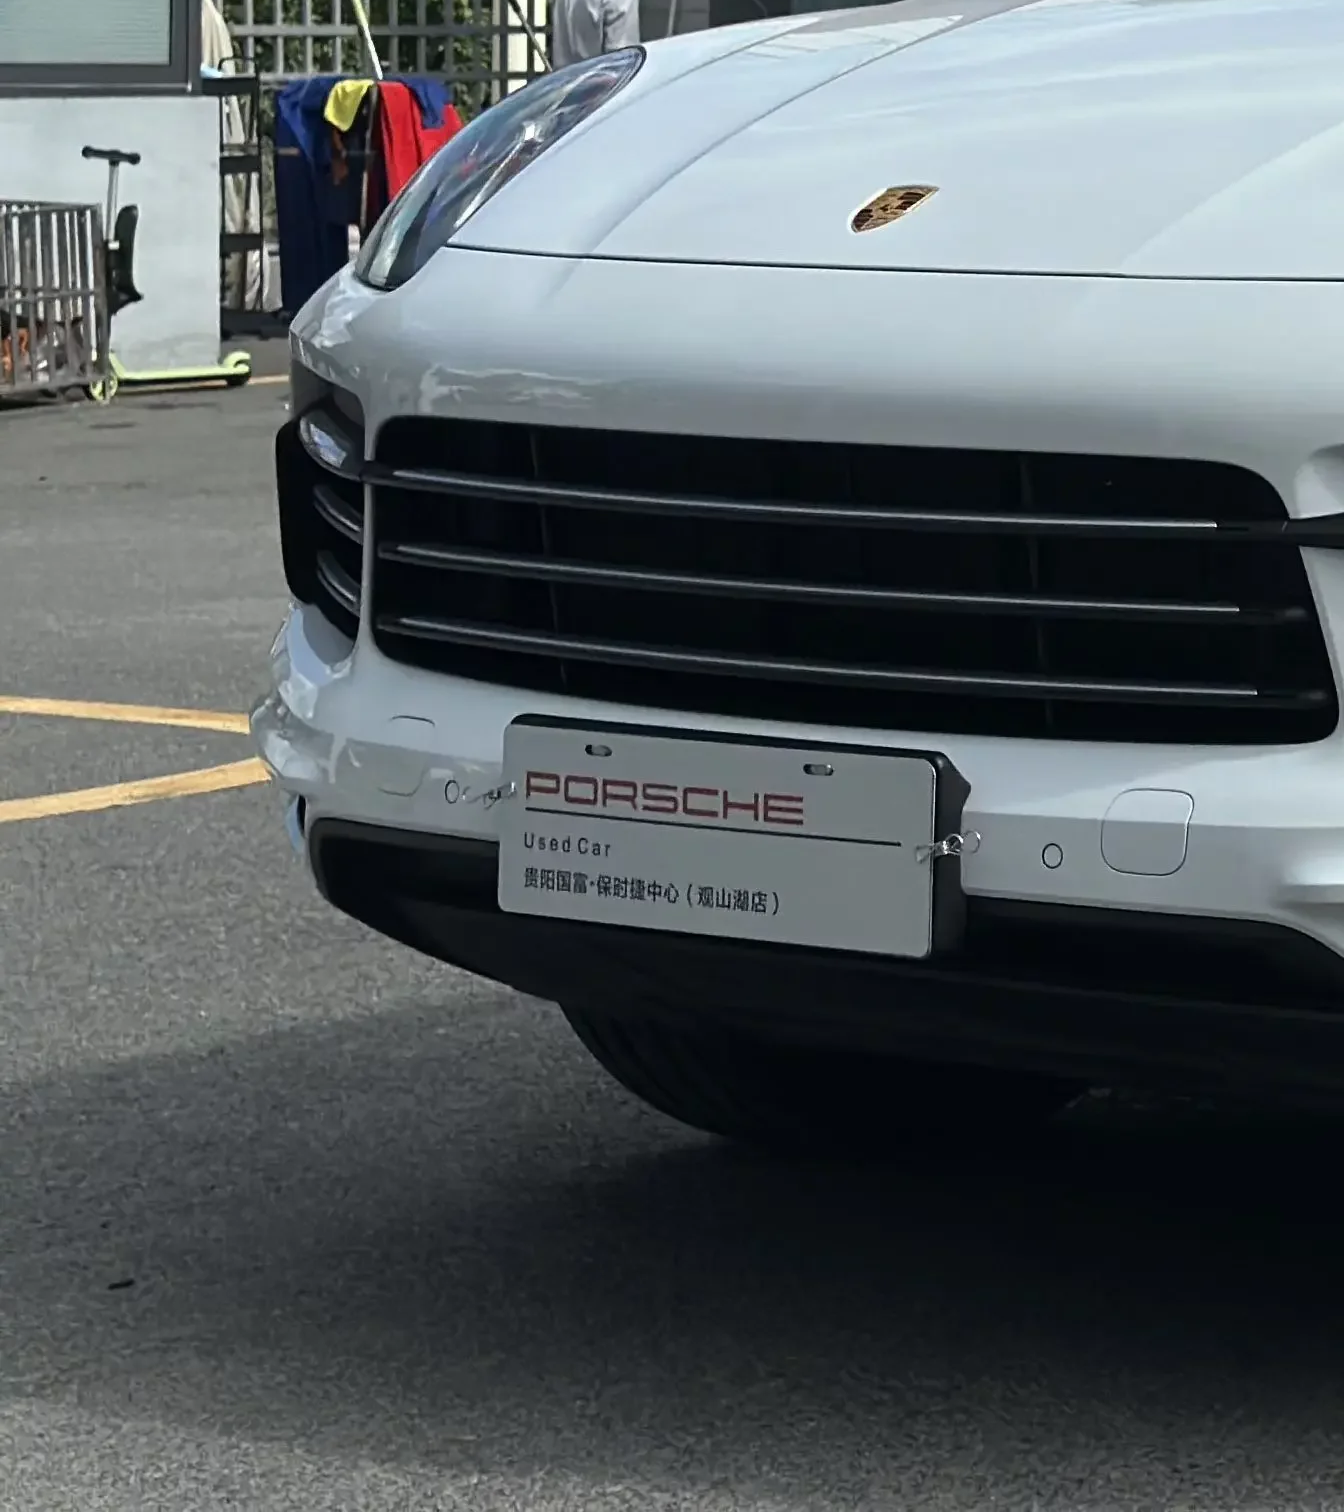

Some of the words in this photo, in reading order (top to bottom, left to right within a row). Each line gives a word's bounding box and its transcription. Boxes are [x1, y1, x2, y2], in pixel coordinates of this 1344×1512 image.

[525, 770, 804, 826] PORSCHE
[523, 831, 571, 854] Used
[577, 837, 611, 857] Car
